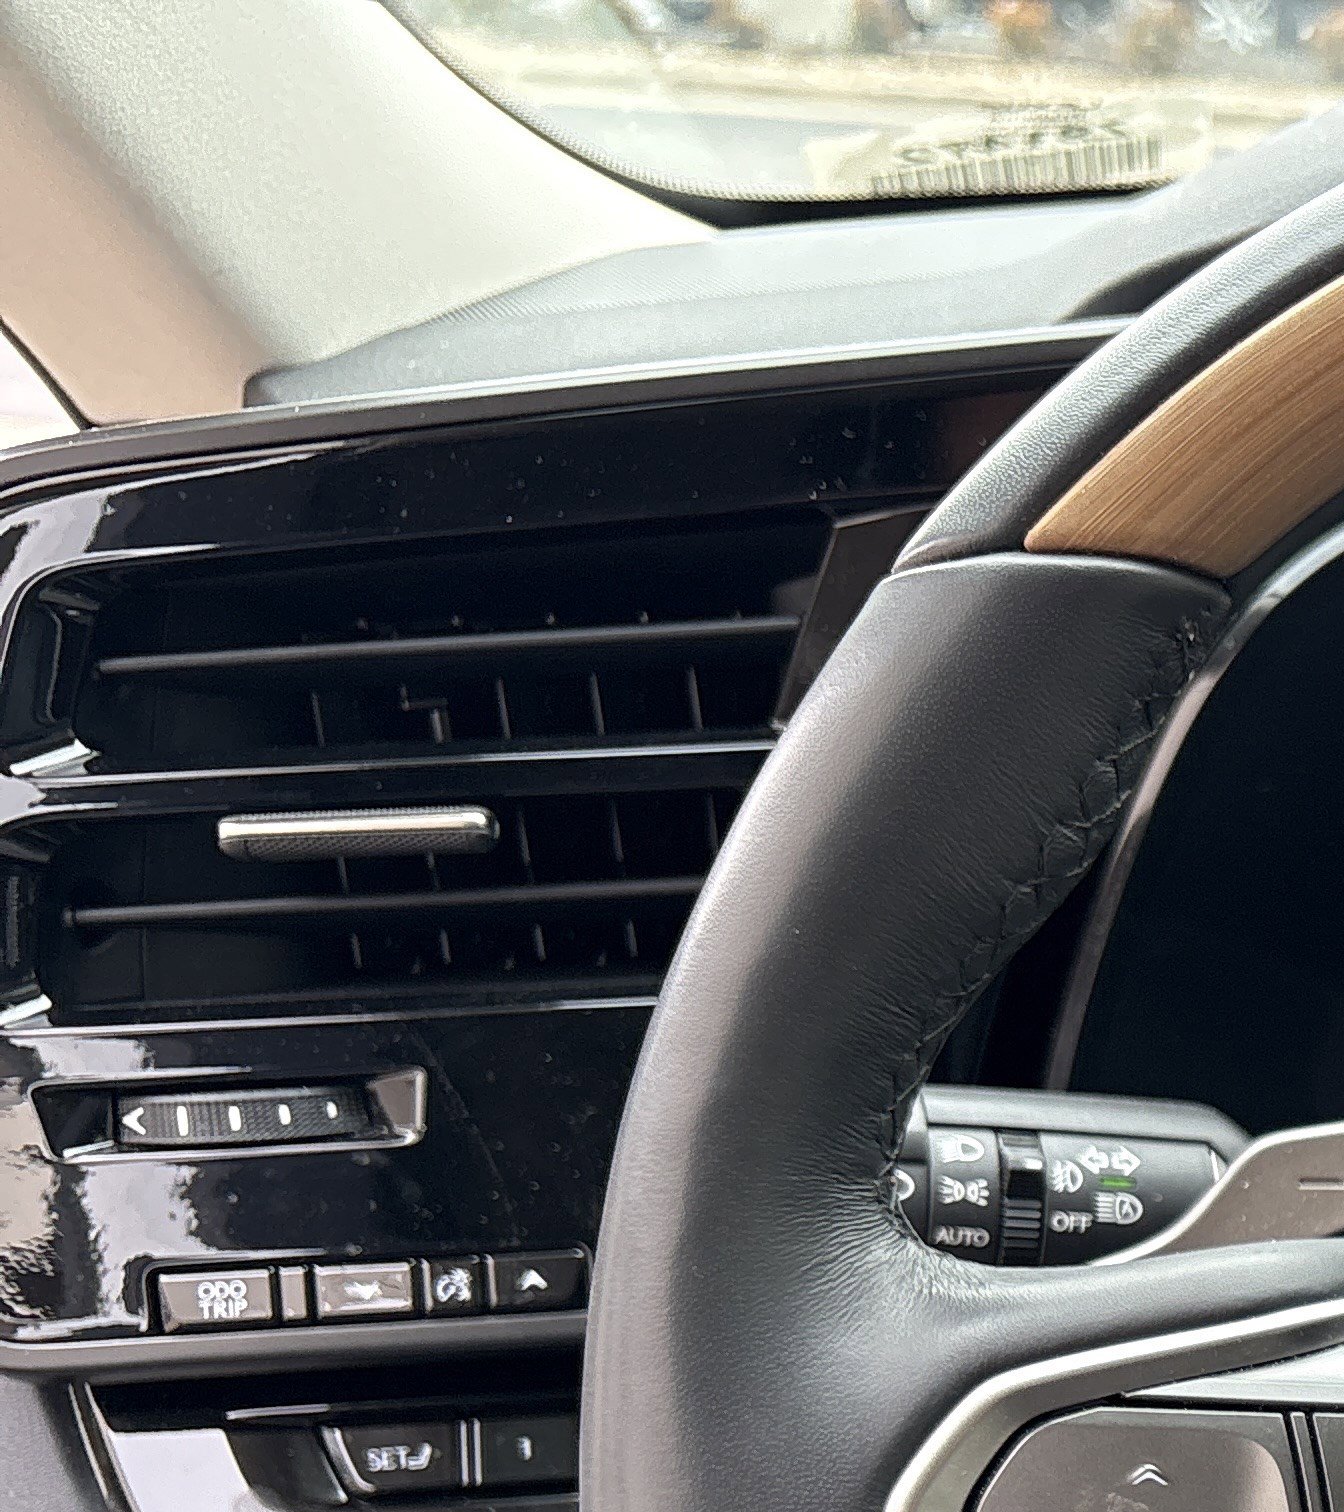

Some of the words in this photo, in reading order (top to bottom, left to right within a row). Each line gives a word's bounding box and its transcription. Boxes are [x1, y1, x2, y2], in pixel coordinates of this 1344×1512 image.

[1050, 1210, 1093, 1234] OFF
[932, 1225, 990, 1249] AUTO
[197, 1279, 248, 1299] ODO
[198, 1299, 248, 1319] TRIP
[366, 1446, 410, 1472] SET
